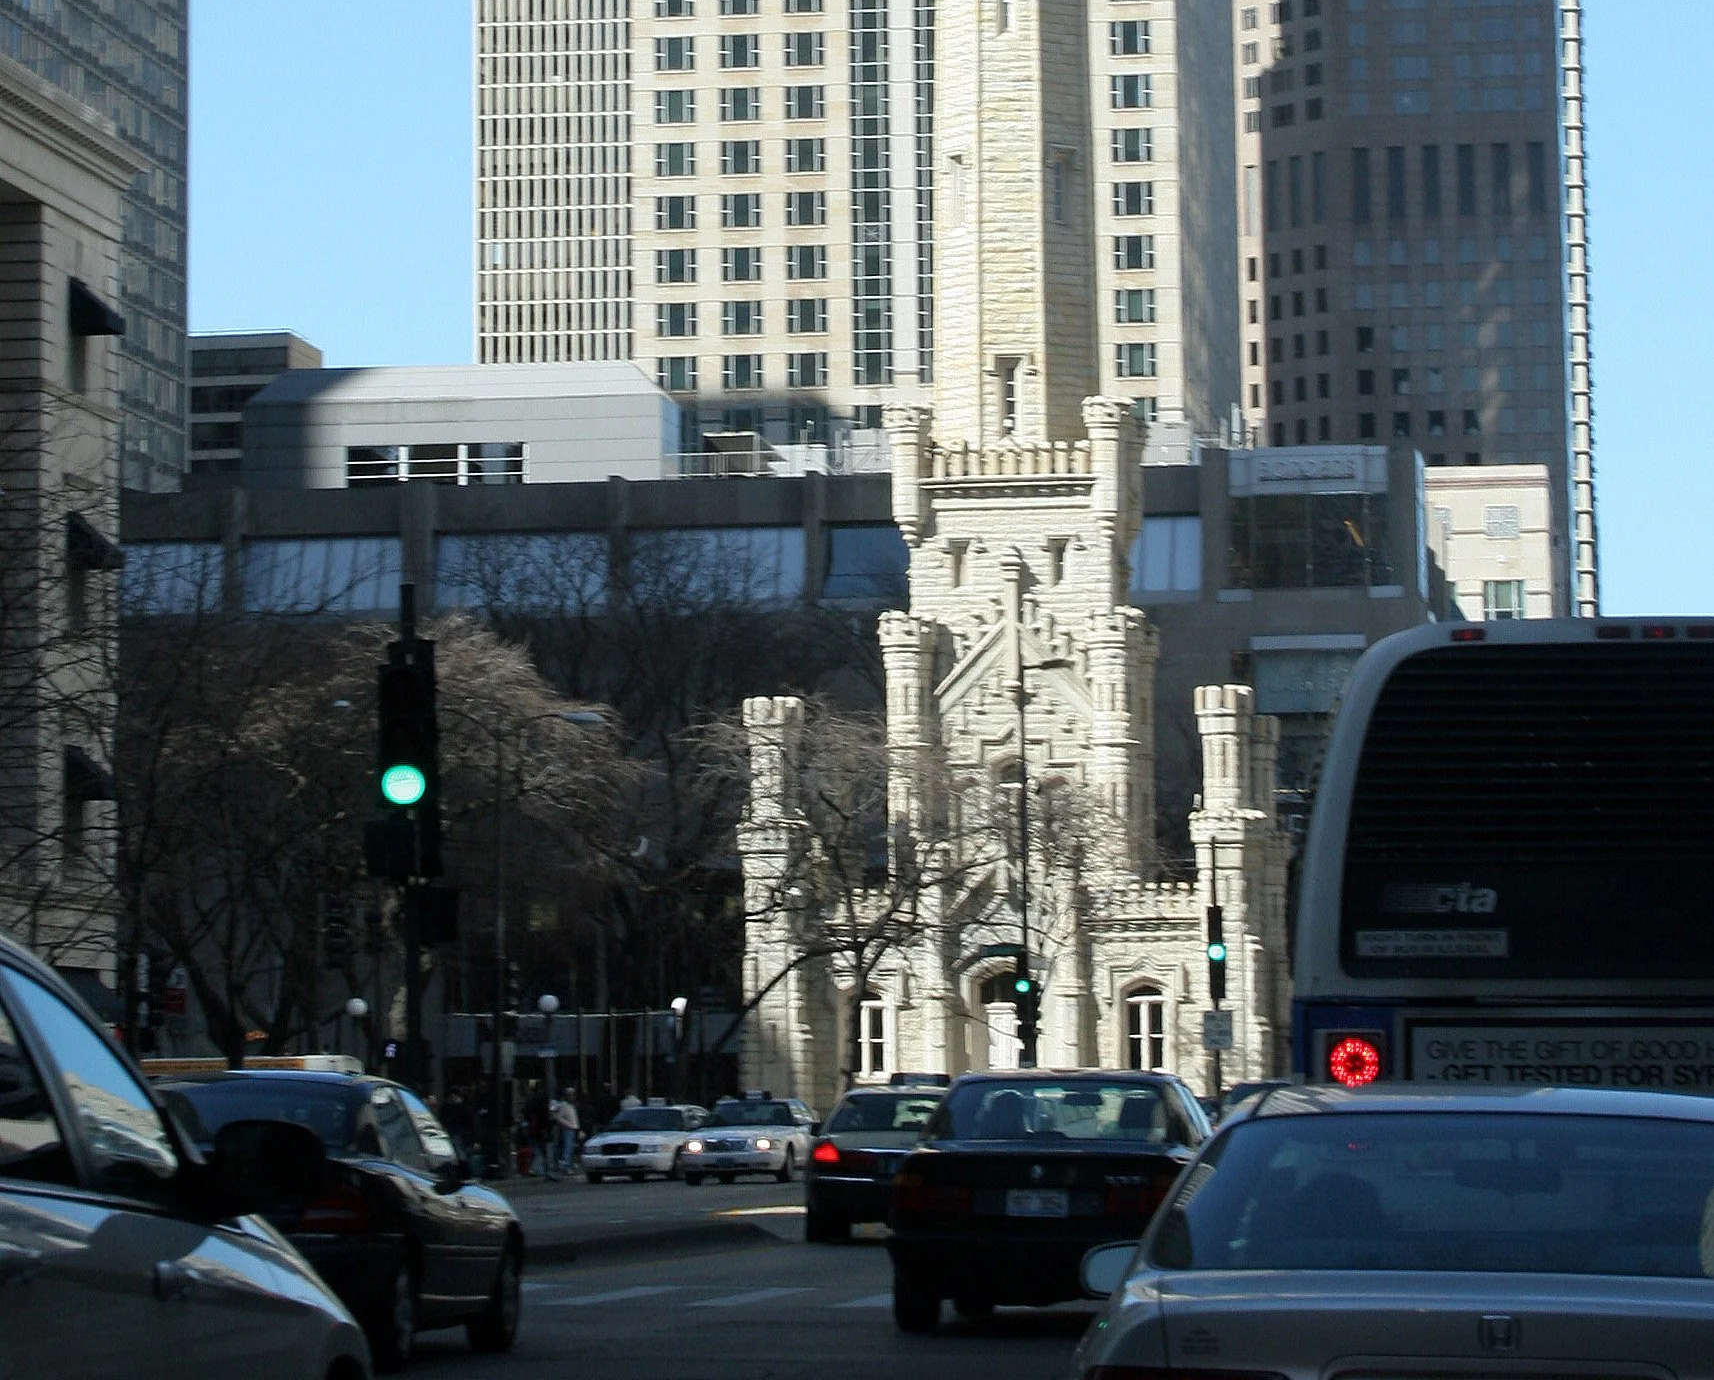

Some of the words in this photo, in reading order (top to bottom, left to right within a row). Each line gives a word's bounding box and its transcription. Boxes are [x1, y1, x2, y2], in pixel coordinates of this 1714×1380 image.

[1426, 1040, 1476, 1060] GIVE
[1486, 1040, 1528, 1060] THE
[1534, 1040, 1584, 1060] GIFT
[1591, 1040, 1621, 1060] OF
[1629, 1040, 1698, 1061] GOOD
[1444, 1064, 1496, 1082] GET
[1504, 1065, 1600, 1085] TESTED
[1611, 1066, 1666, 1086] FOR
